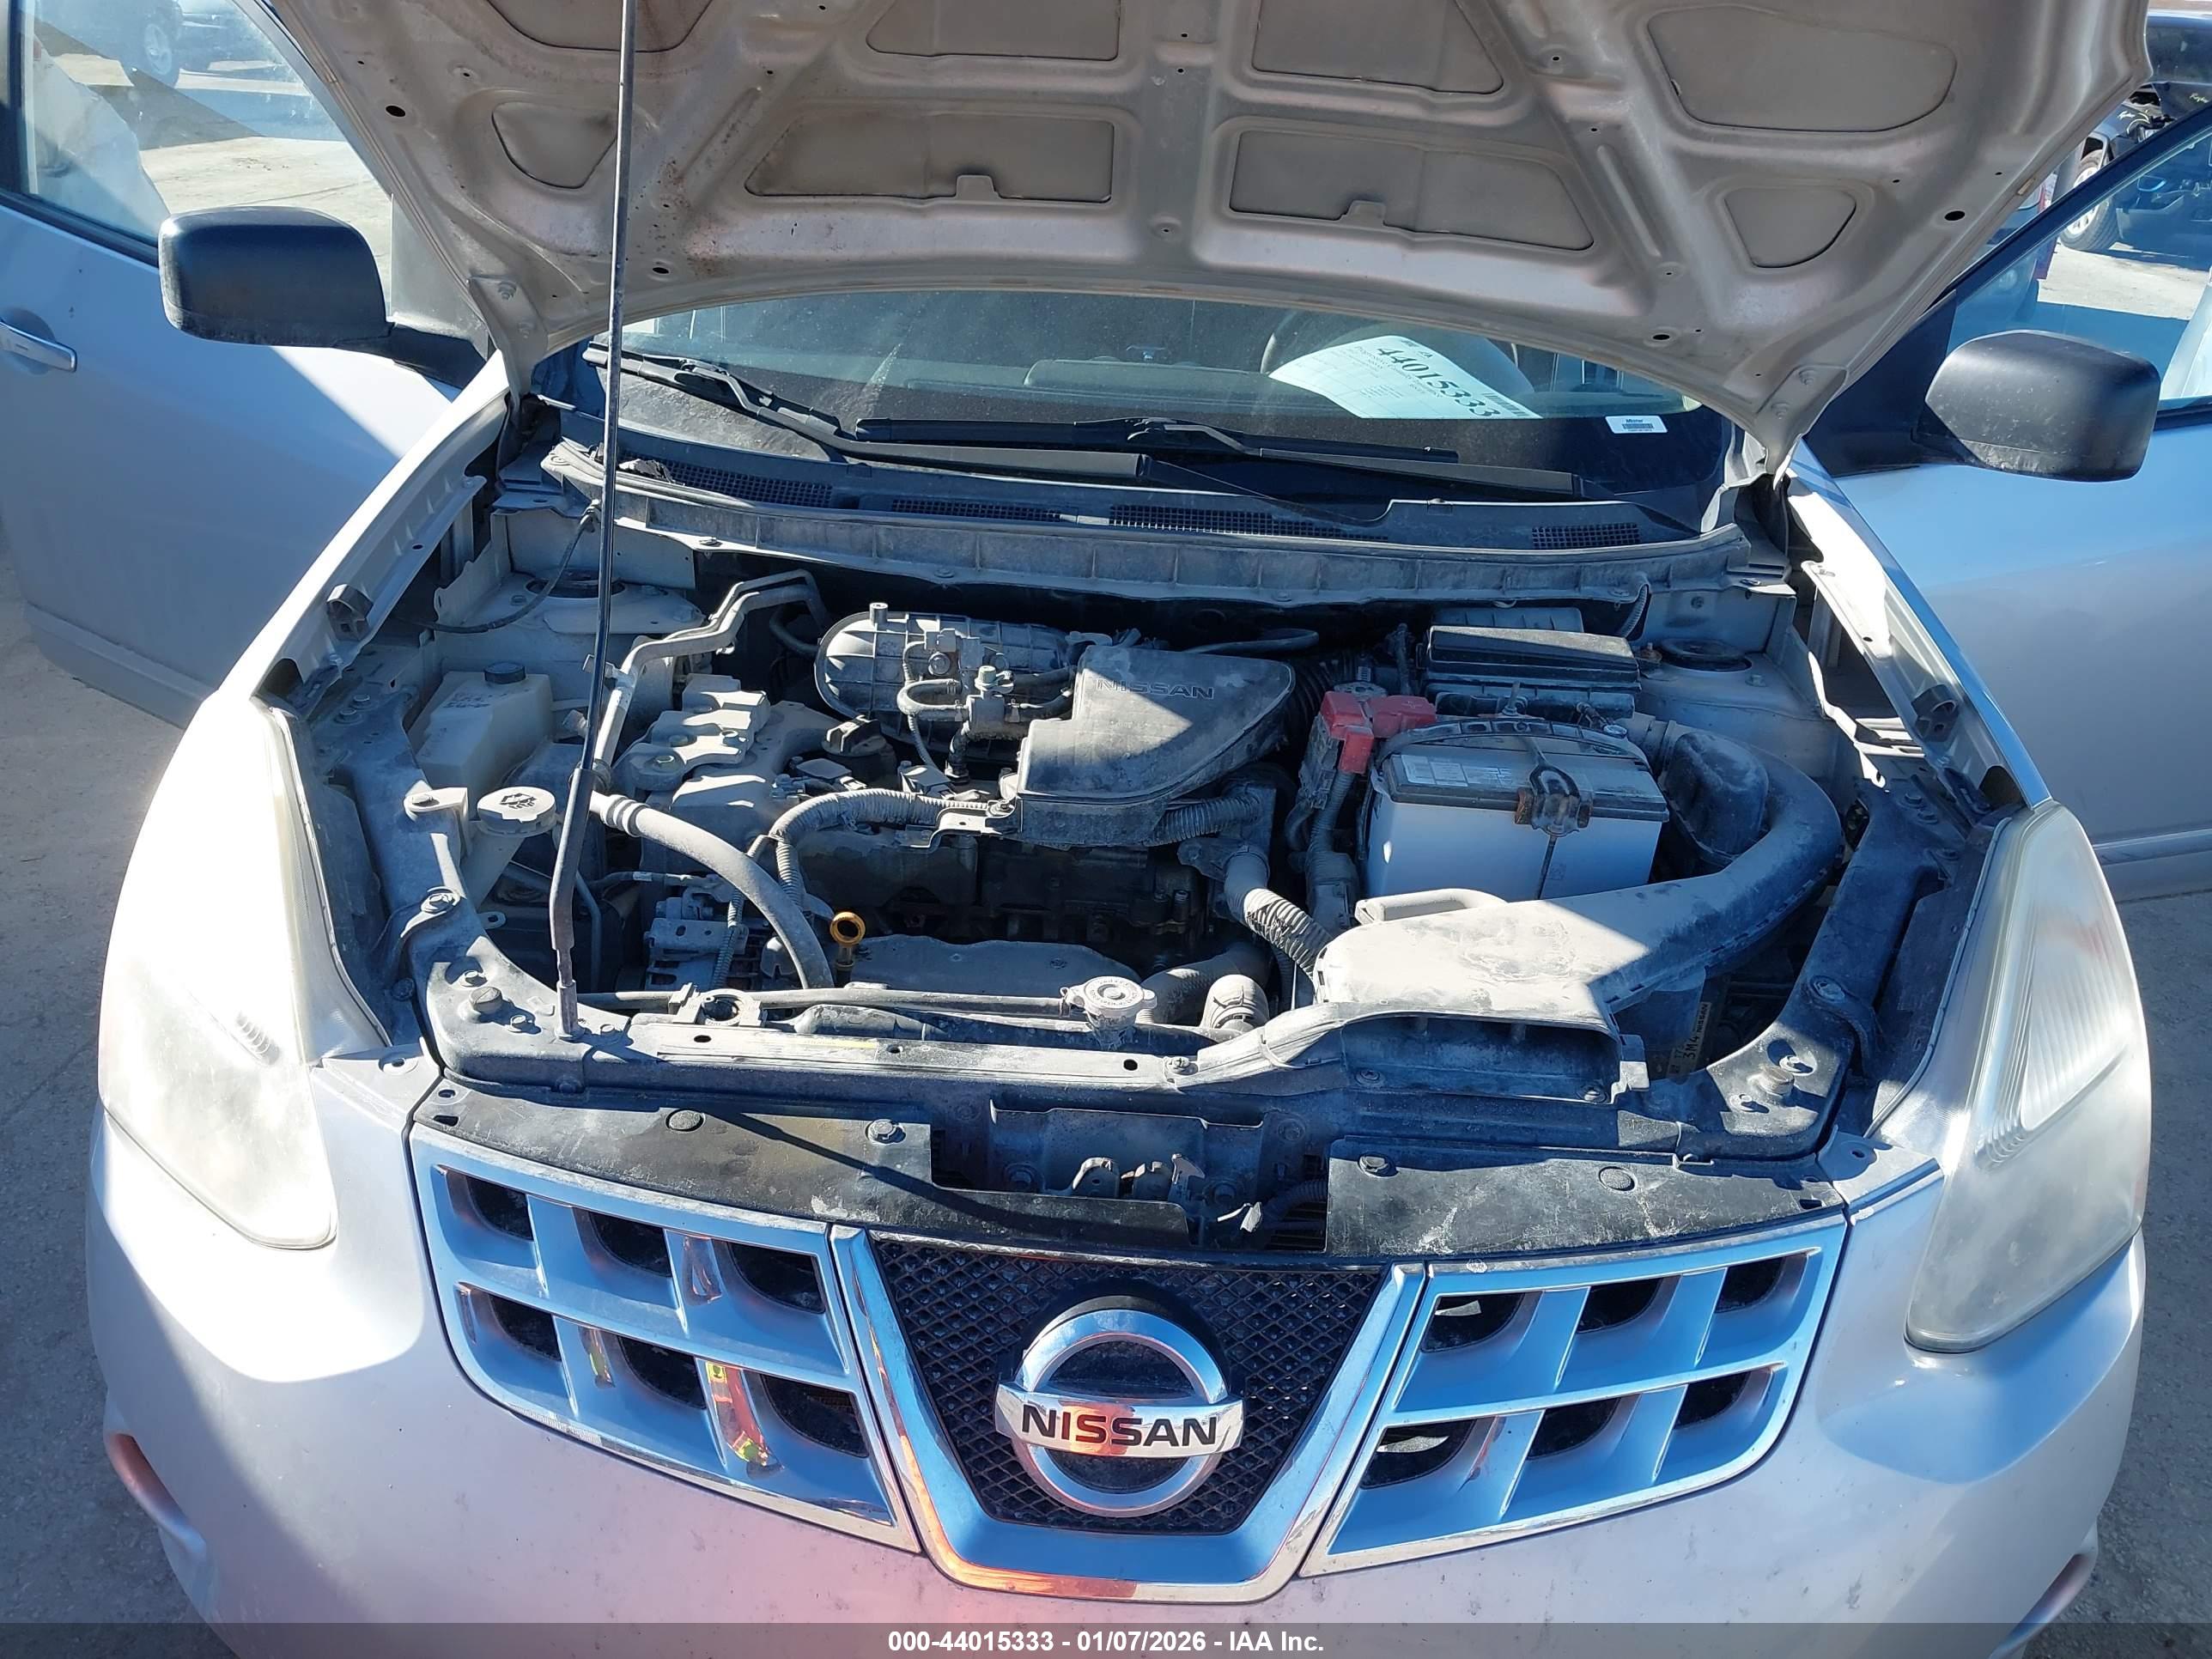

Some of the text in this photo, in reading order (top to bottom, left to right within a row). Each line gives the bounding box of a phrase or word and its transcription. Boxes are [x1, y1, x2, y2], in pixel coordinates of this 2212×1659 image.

[1377, 348, 1501, 416] 44015333
[1096, 679, 1214, 699] NISSAN
[1020, 1405, 1218, 1447] NISSAN
